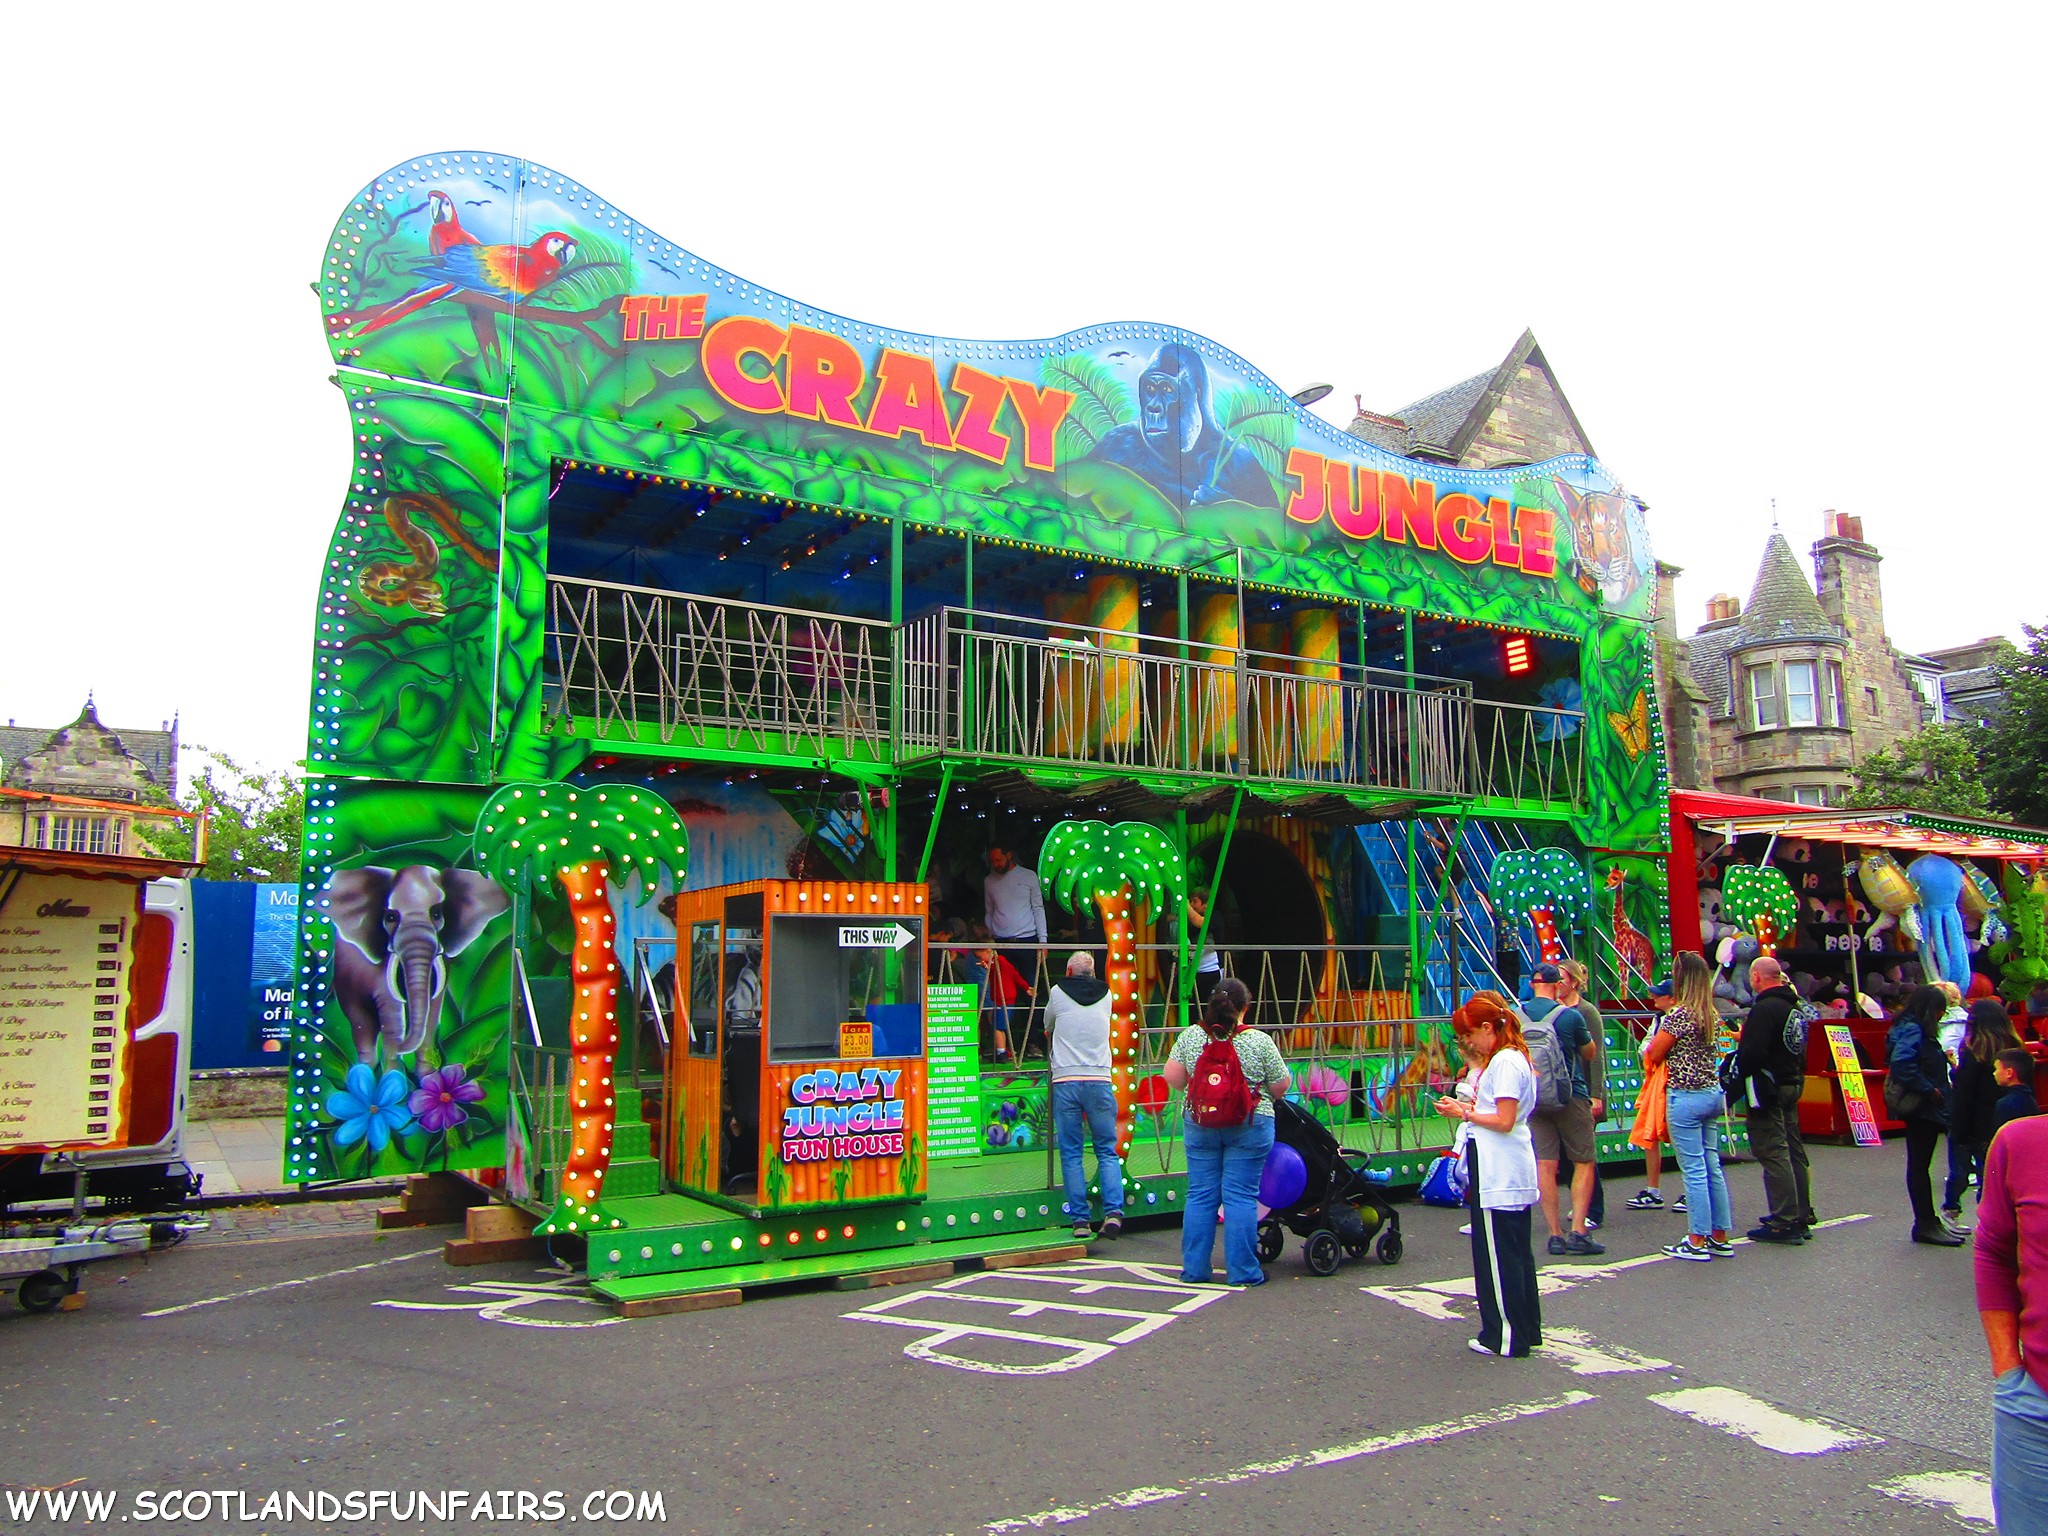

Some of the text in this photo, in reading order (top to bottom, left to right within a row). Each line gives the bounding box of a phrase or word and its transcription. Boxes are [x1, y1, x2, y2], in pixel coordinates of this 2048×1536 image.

[619, 293, 1558, 578] THE CRAZY JUNGLE
[843, 929, 897, 944] THIS WAY
[263, 1006, 281, 1021] of
[845, 1025, 868, 1033] fare
[1829, 1030, 1852, 1043] SCORE
[844, 1035, 869, 1046] £3.00
[1836, 1046, 1853, 1058] OVER
[792, 1067, 902, 1104] CRAZY
[1850, 1100, 1867, 1120] TO
[783, 1100, 905, 1138] JUNGLE
[1852, 1122, 1878, 1140] WIN
[783, 1132, 904, 1162] FUN HOUSE
